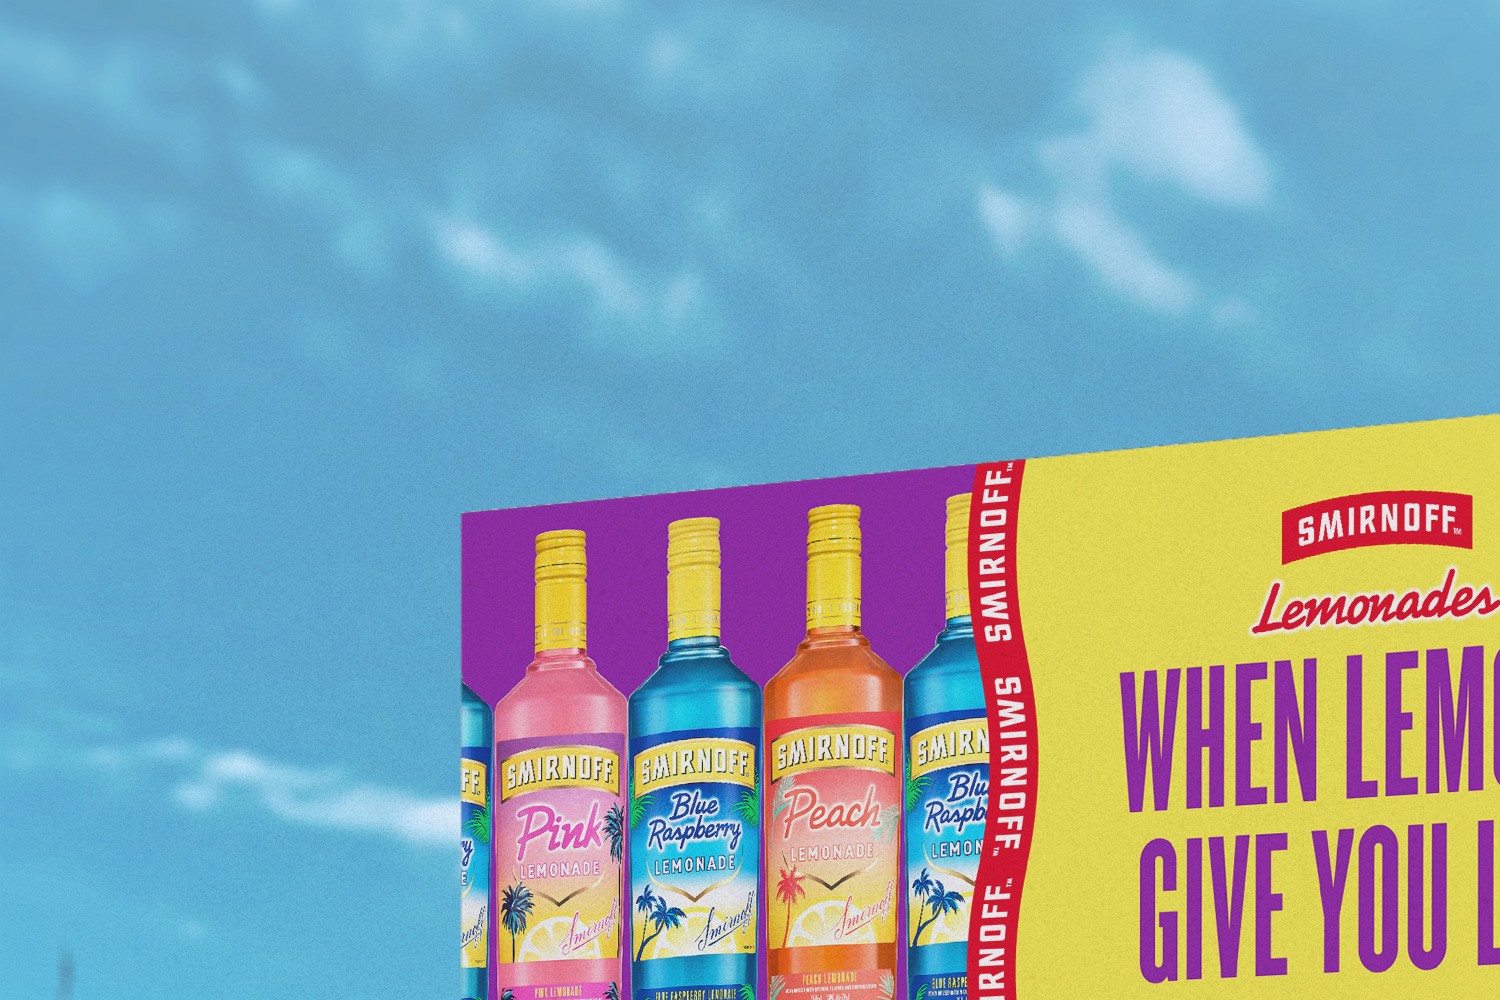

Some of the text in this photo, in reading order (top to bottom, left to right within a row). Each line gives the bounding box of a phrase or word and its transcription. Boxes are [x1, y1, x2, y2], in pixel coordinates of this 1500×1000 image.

[1119, 657, 1318, 813] WHEN
[947, 772, 988, 802] Blu
[669, 790, 718, 820] Blue
[784, 785, 881, 839] Peach
[516, 801, 603, 861] Pink
[648, 815, 741, 850] Raspberry
[655, 854, 736, 875] LEMONADE
[791, 842, 874, 862] LEMONADE
[519, 859, 601, 881] LEMONADE
[1139, 832, 1289, 984] GIVE
[1311, 822, 1448, 974] YOU
